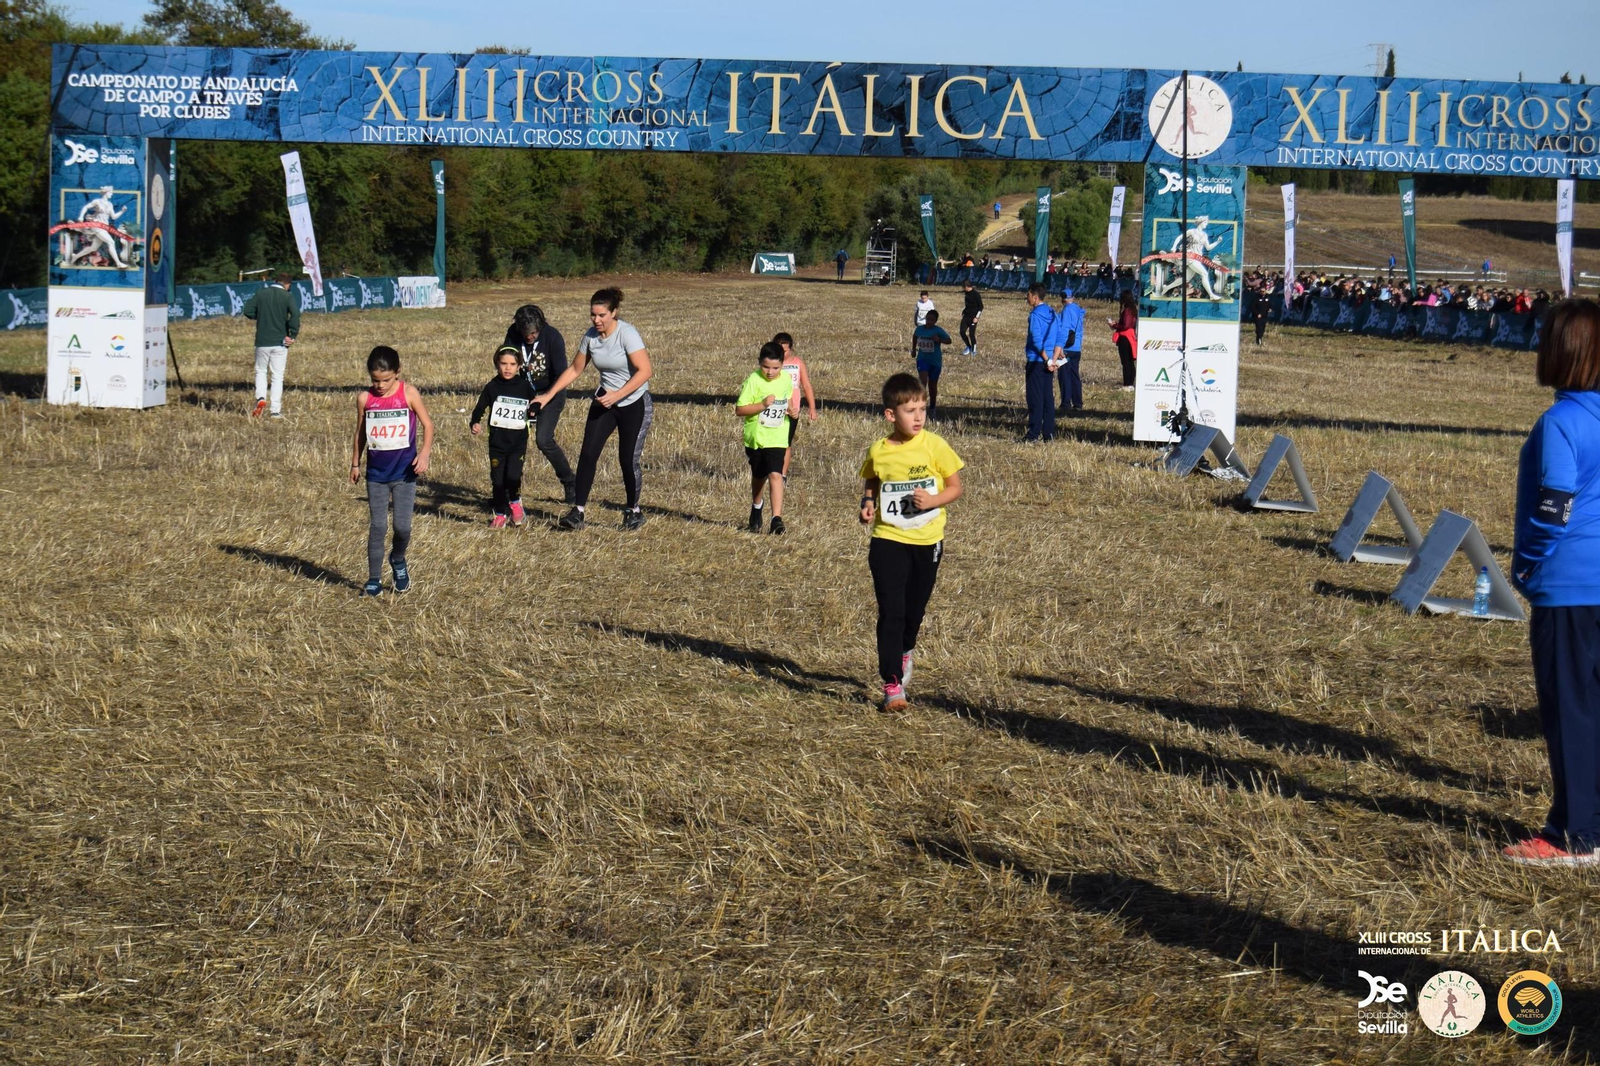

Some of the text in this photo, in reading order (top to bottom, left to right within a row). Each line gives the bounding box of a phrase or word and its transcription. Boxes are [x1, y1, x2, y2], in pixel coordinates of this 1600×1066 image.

[68, 73, 299, 92] CAMPEONATO DE ANDALUCÍA
[534, 71, 664, 104] CROSS
[104, 89, 263, 105] DE CAMPO A TRAVÉS
[364, 66, 529, 124] XLIII
[724, 61, 1046, 141] ITÁLICA
[140, 105, 230, 120] POR CLUBES
[533, 107, 712, 127] INTERNACIONAL
[1282, 86, 1453, 148] XLIII
[1457, 94, 1592, 132] CROSS
[362, 126, 680, 147] INTERNATIONAL CROSS COUNTRY
[1457, 131, 1600, 154] INTERNACIO
[101, 155, 135, 165] Sevilla
[1278, 147, 1440, 170] INTERNATIONAL
[1444, 153, 1505, 171] CROSS
[1196, 175, 1232, 184] Diputación
[1196, 184, 1232, 195] Sevilla
[28, 308, 48, 325] Sevill
[495, 407, 524, 420] 4218
[370, 424, 407, 439] 4472
